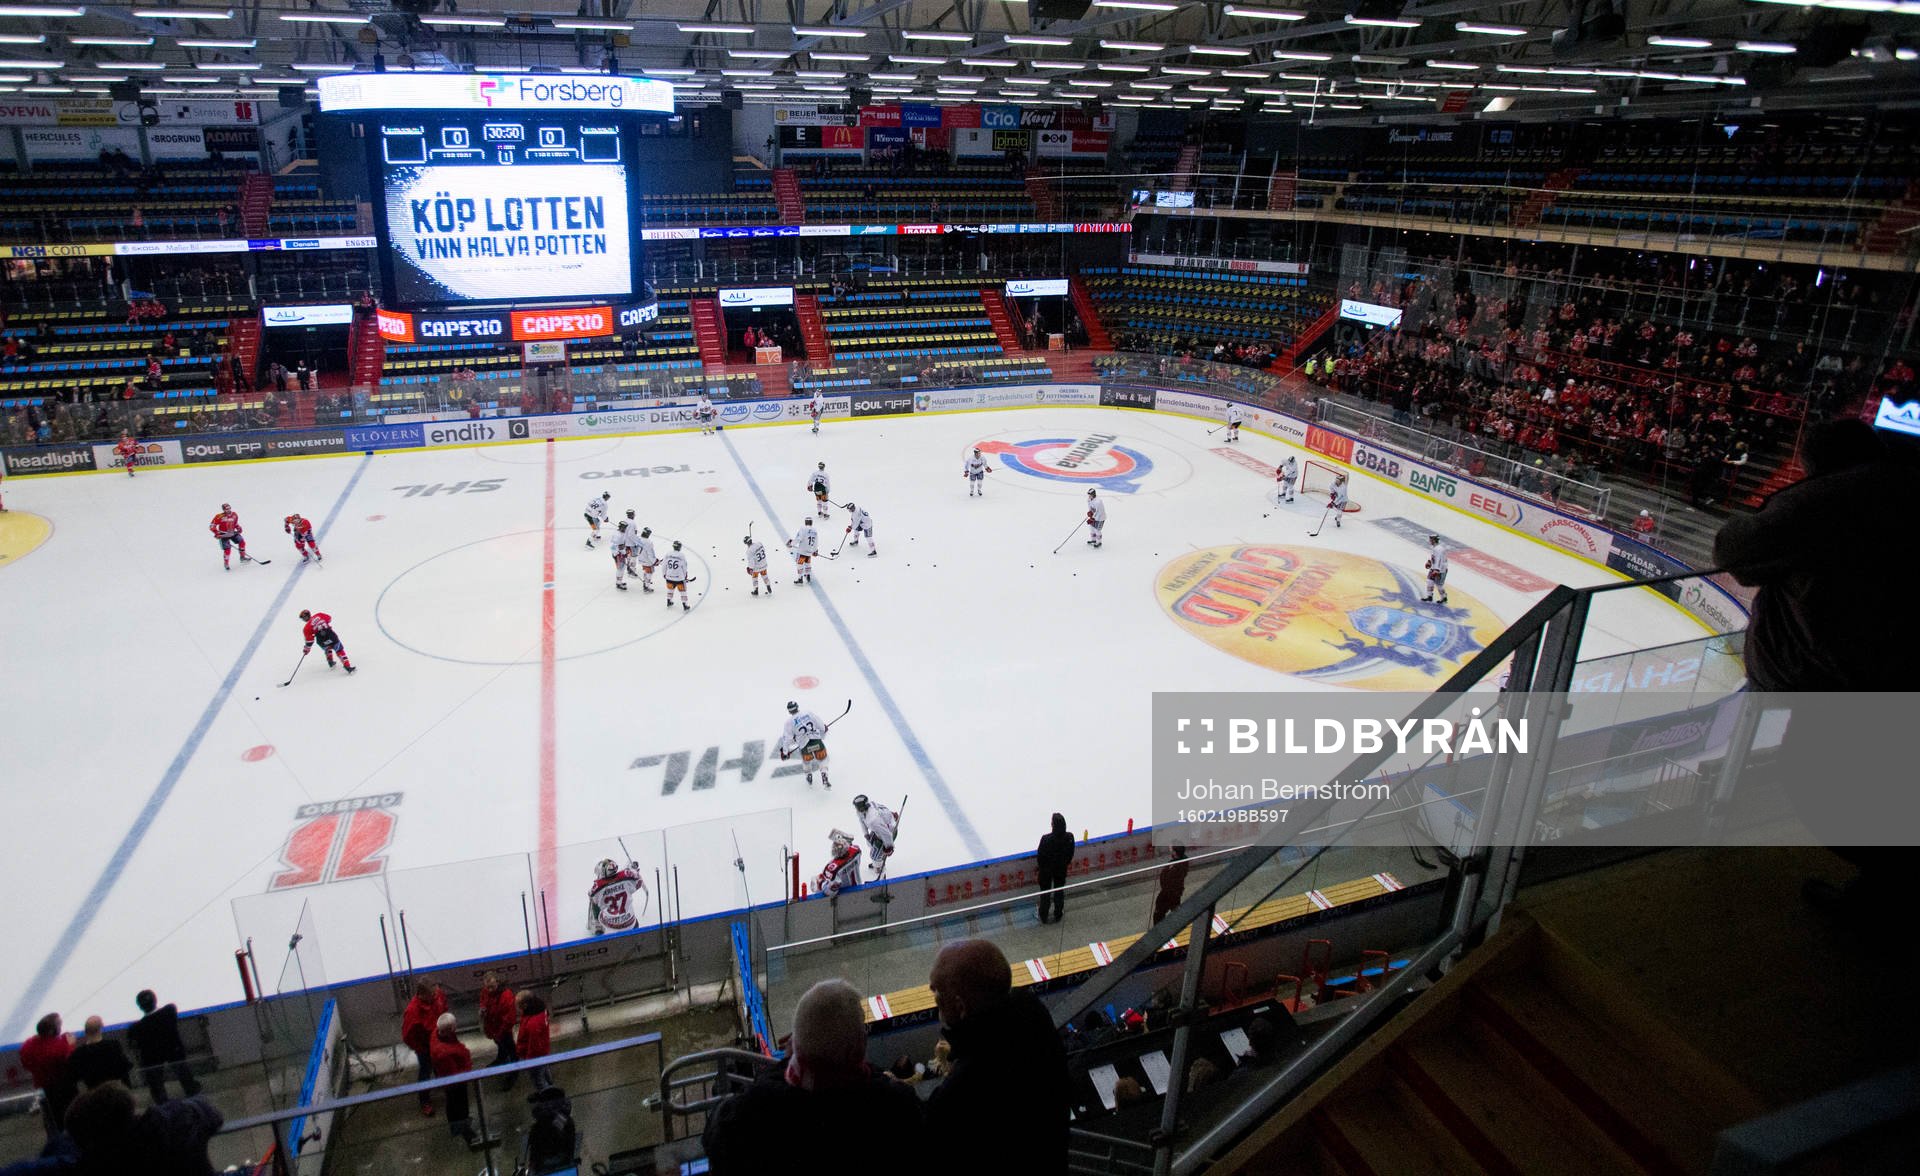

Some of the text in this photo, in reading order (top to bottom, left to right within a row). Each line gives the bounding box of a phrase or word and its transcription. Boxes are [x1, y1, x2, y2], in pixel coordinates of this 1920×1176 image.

[519, 78, 623, 108] Forsberg
[194, 107, 228, 118] Strateg
[25, 133, 81, 141] HERCULES
[453, 131, 463, 144] 0
[488, 127, 520, 139] 30:50
[545, 131, 555, 144] 0
[411, 192, 606, 233] KÖP LOTTEN
[415, 234, 607, 259] VINN HALVA POTTEN
[420, 319, 502, 337] CAPERIO
[521, 313, 603, 333] CAPERIO
[720, 406, 748, 416] MOAB
[753, 403, 780, 413] MOAB
[854, 401, 882, 411] SOUL
[1157, 397, 1210, 411] Handelsbanken
[351, 429, 420, 442] KLÖVERN
[1273, 422, 1304, 438] EASTON
[278, 438, 344, 449] CONVENTUM
[186, 445, 223, 457] SOUL
[1055, 434, 1117, 468] Therma
[8, 450, 91, 467] headlight
[1355, 445, 1400, 479] ÖBAB
[393, 478, 507, 498] SHL
[1410, 470, 1456, 497] DANFO
[1469, 493, 1507, 517] EEL
[756, 549, 766, 561] 33
[667, 560, 679, 569] 66
[604, 890, 627, 915] 37
